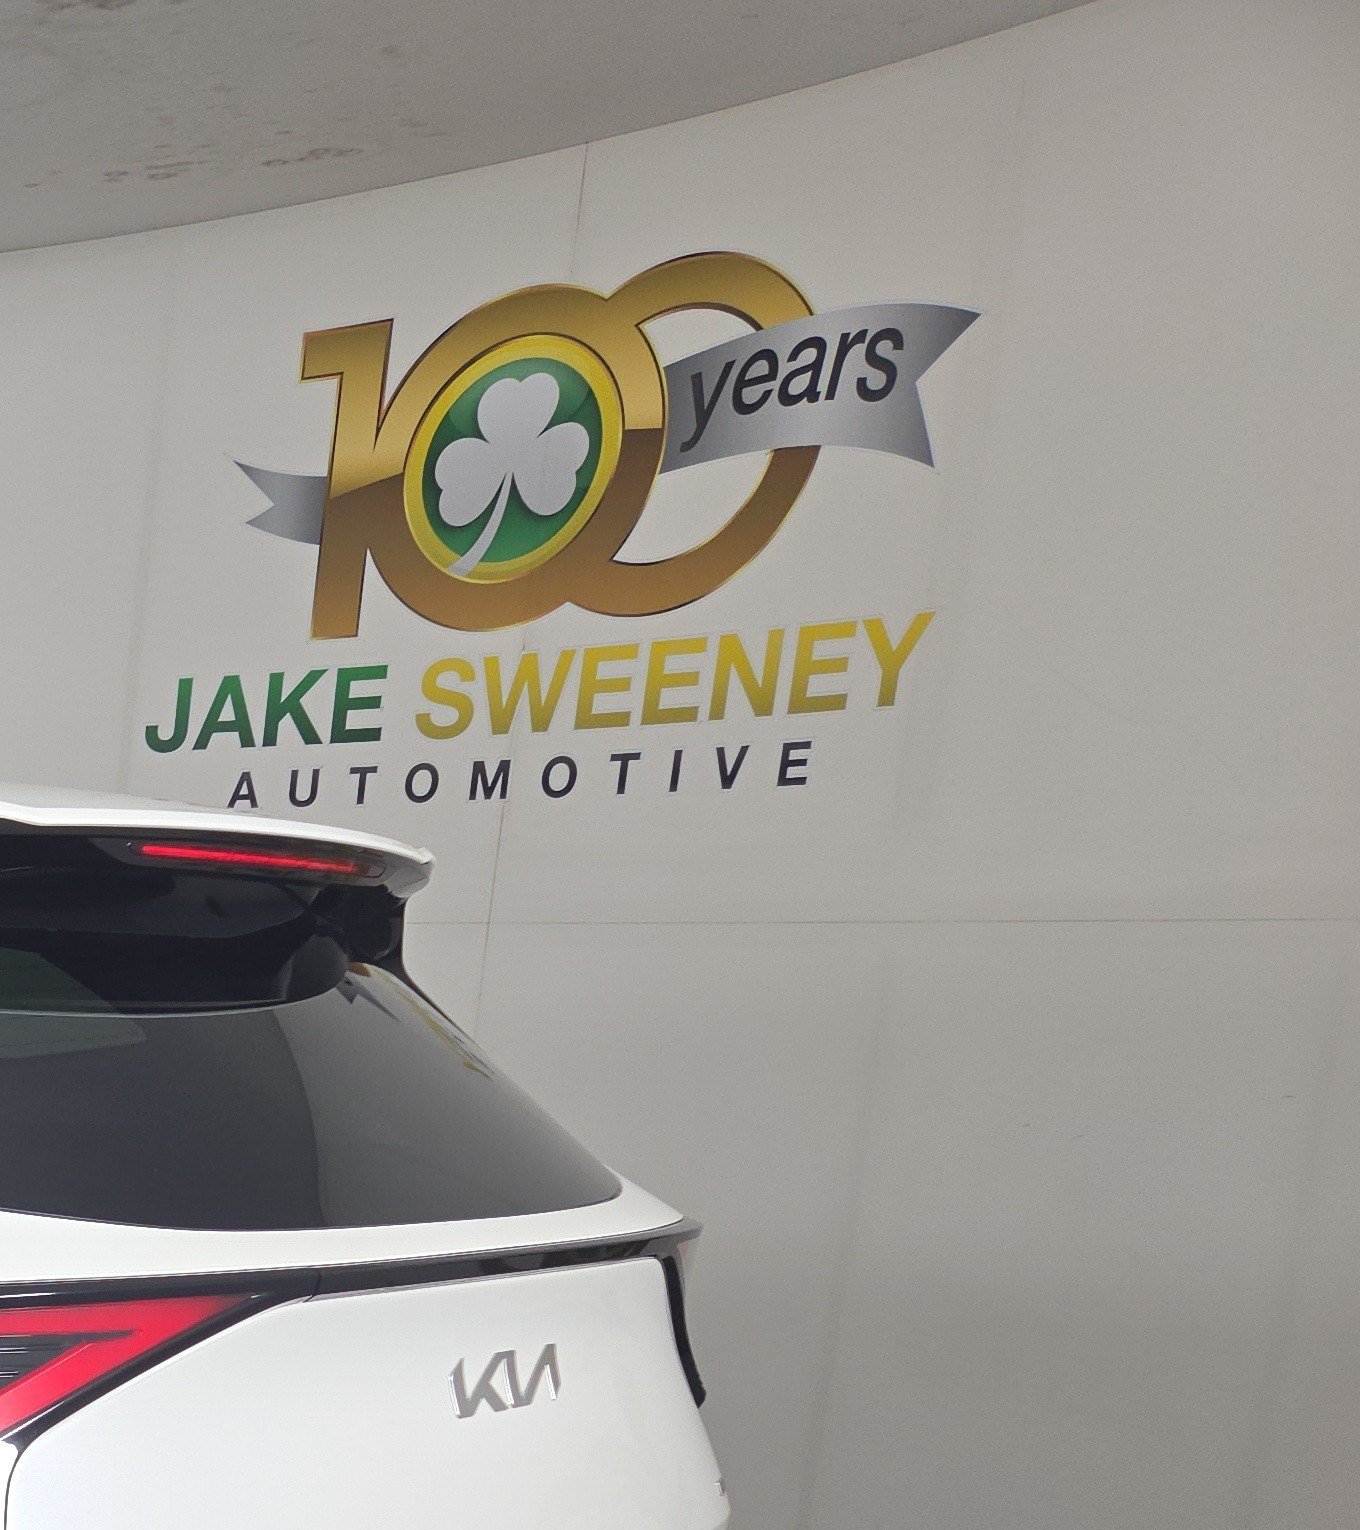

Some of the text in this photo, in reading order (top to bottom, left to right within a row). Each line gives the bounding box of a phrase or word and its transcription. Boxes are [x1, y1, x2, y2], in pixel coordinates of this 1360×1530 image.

[681, 328, 904, 452] years
[145, 611, 935, 753] JAKE SWEENEY
[227, 741, 814, 810] AUTOMOTIVE
[447, 1343, 561, 1418] KIA
